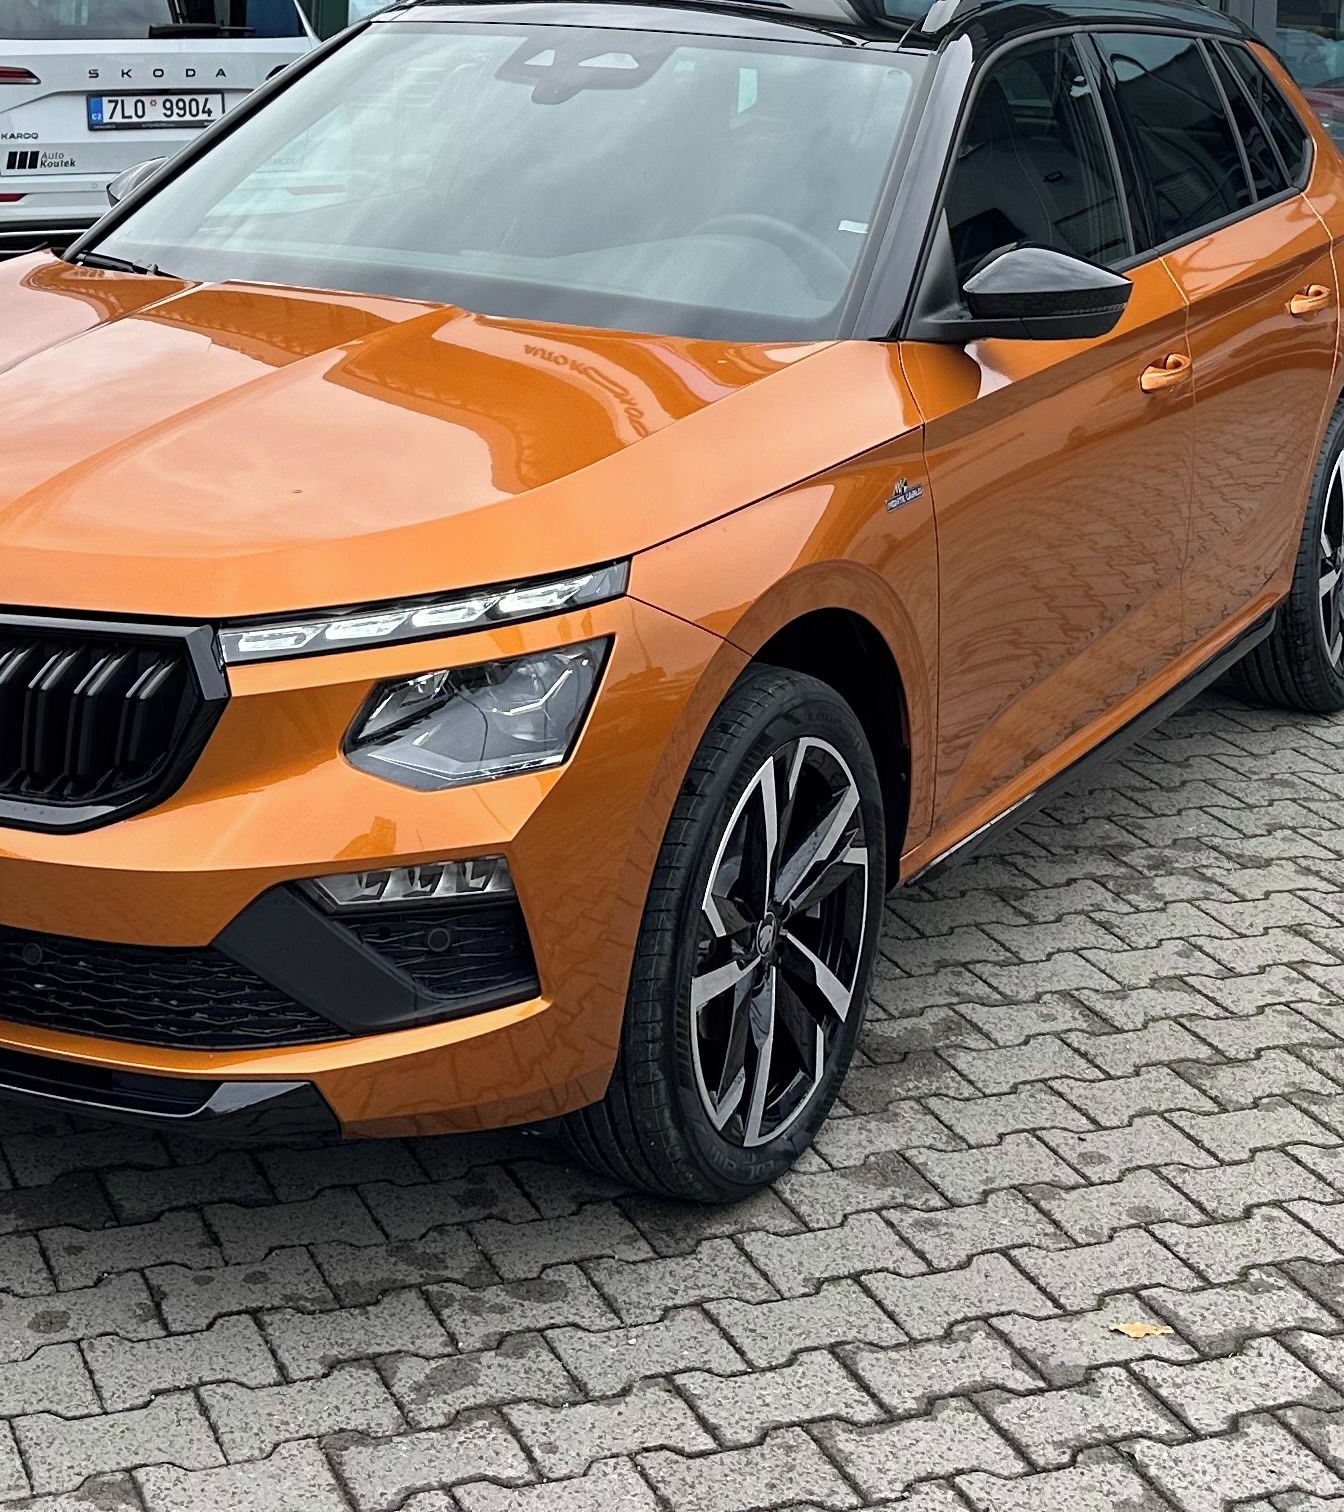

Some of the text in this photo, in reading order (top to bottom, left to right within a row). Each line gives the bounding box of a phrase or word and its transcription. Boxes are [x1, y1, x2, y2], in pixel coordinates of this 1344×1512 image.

[107, 98, 146, 120] 7L0
[162, 98, 213, 118] 9904
[1, 132, 39, 140] KAROQ
[41, 152, 65, 160] Auto
[40, 158, 76, 168] Koutek
